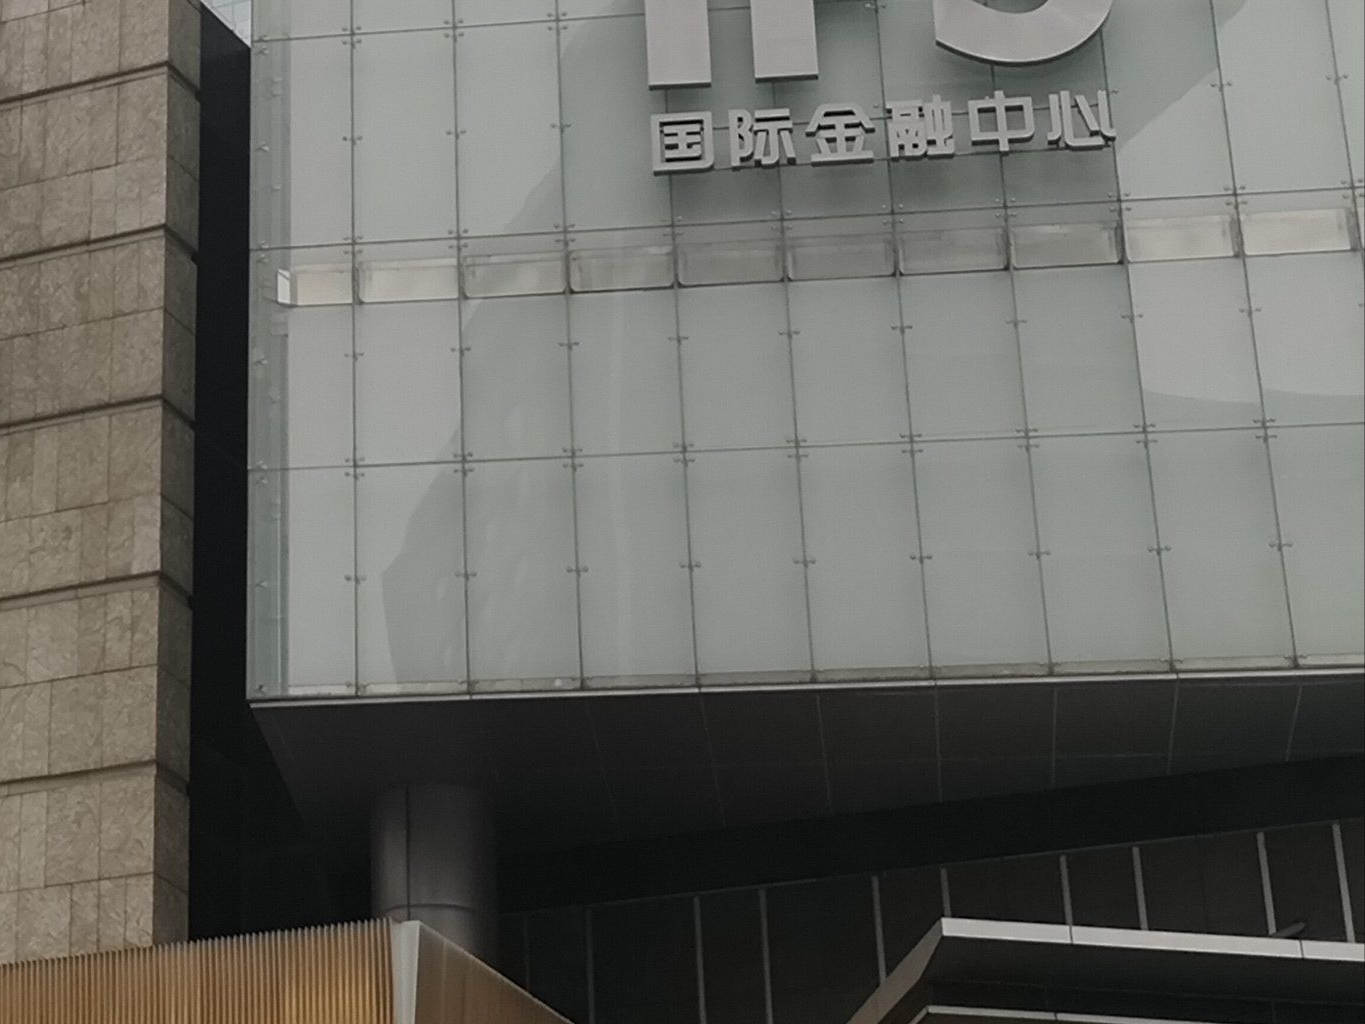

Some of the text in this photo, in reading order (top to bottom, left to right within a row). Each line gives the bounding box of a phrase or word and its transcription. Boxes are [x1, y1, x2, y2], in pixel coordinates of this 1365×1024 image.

[650, 90, 1116, 175] 国际金融中心
